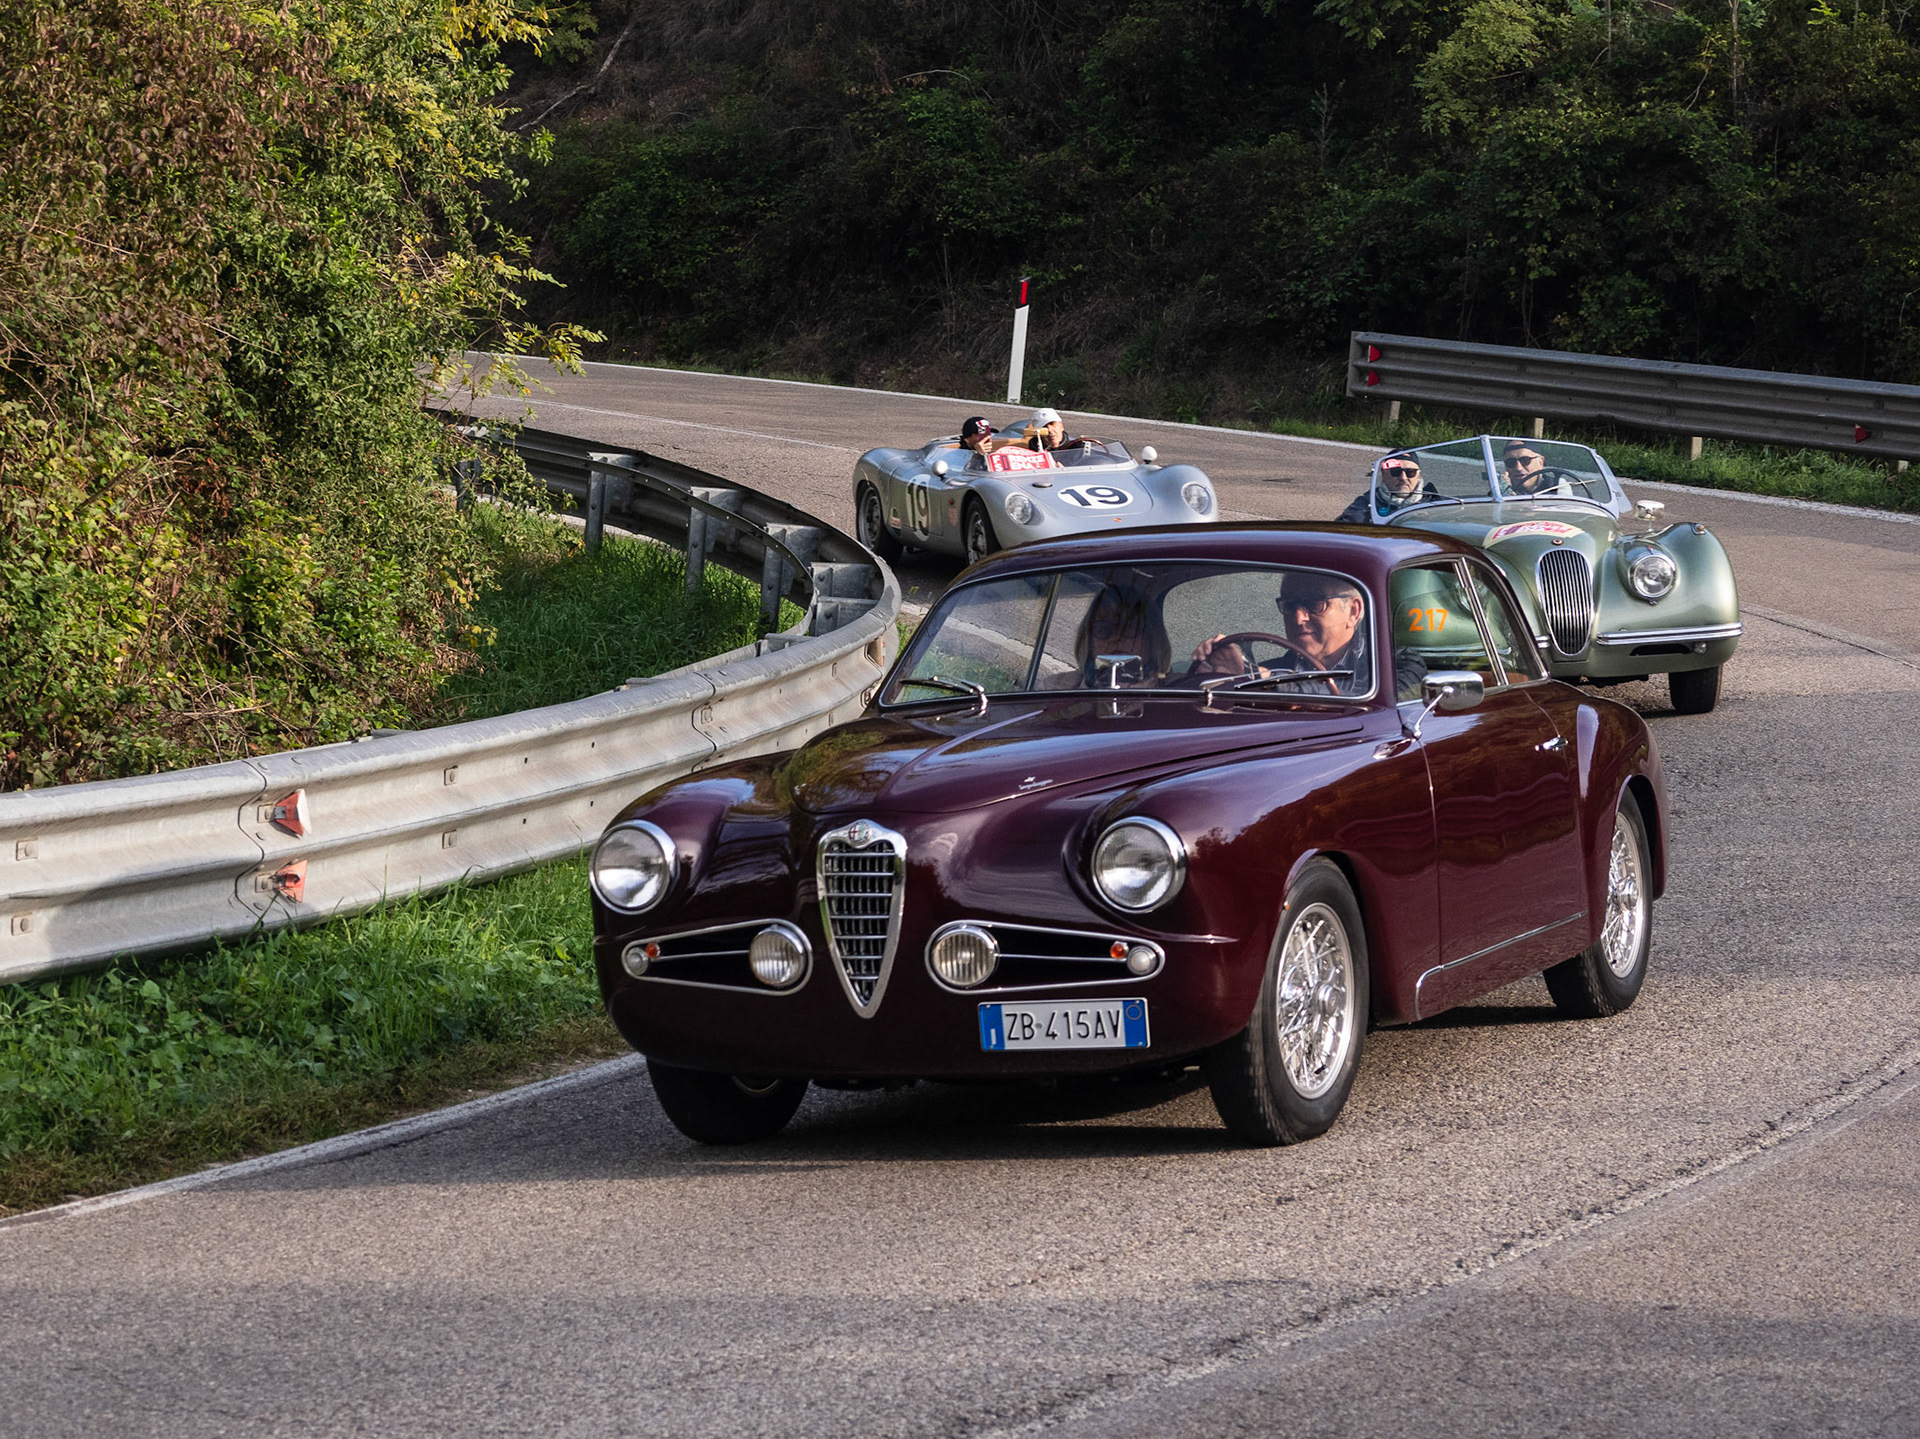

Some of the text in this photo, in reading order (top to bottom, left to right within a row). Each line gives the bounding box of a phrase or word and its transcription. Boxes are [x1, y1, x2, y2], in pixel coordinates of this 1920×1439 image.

[1060, 487, 1128, 506] 19
[908, 482, 929, 536] 19
[1408, 608, 1449, 631] 217
